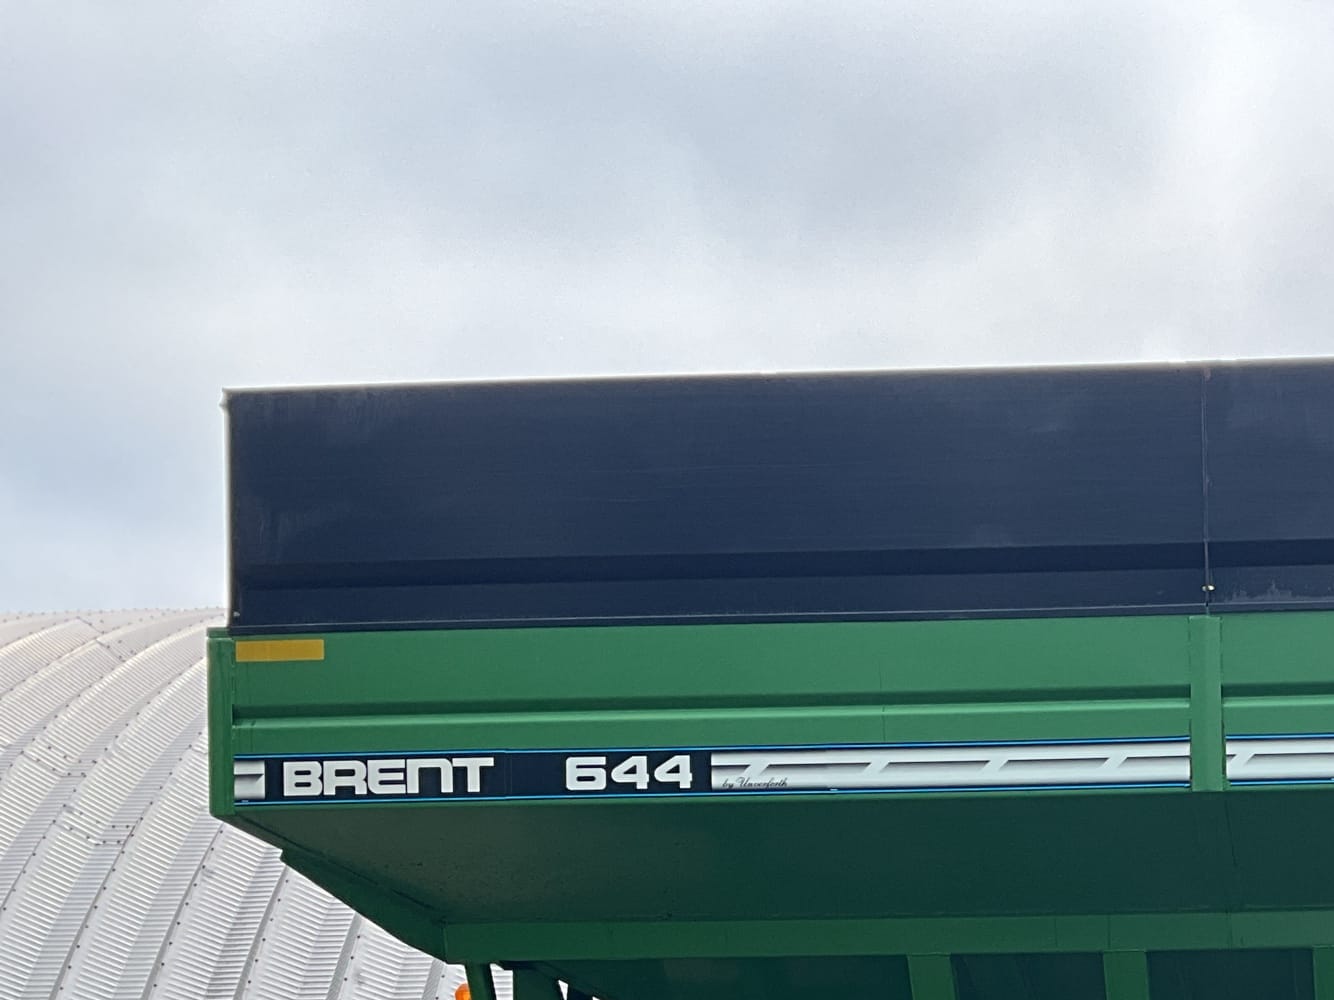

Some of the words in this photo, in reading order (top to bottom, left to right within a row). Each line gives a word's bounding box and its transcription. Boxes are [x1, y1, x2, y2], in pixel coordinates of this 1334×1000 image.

[283, 757, 494, 796] BRENT
[565, 755, 693, 791] 644
[722, 778, 734, 789] by
